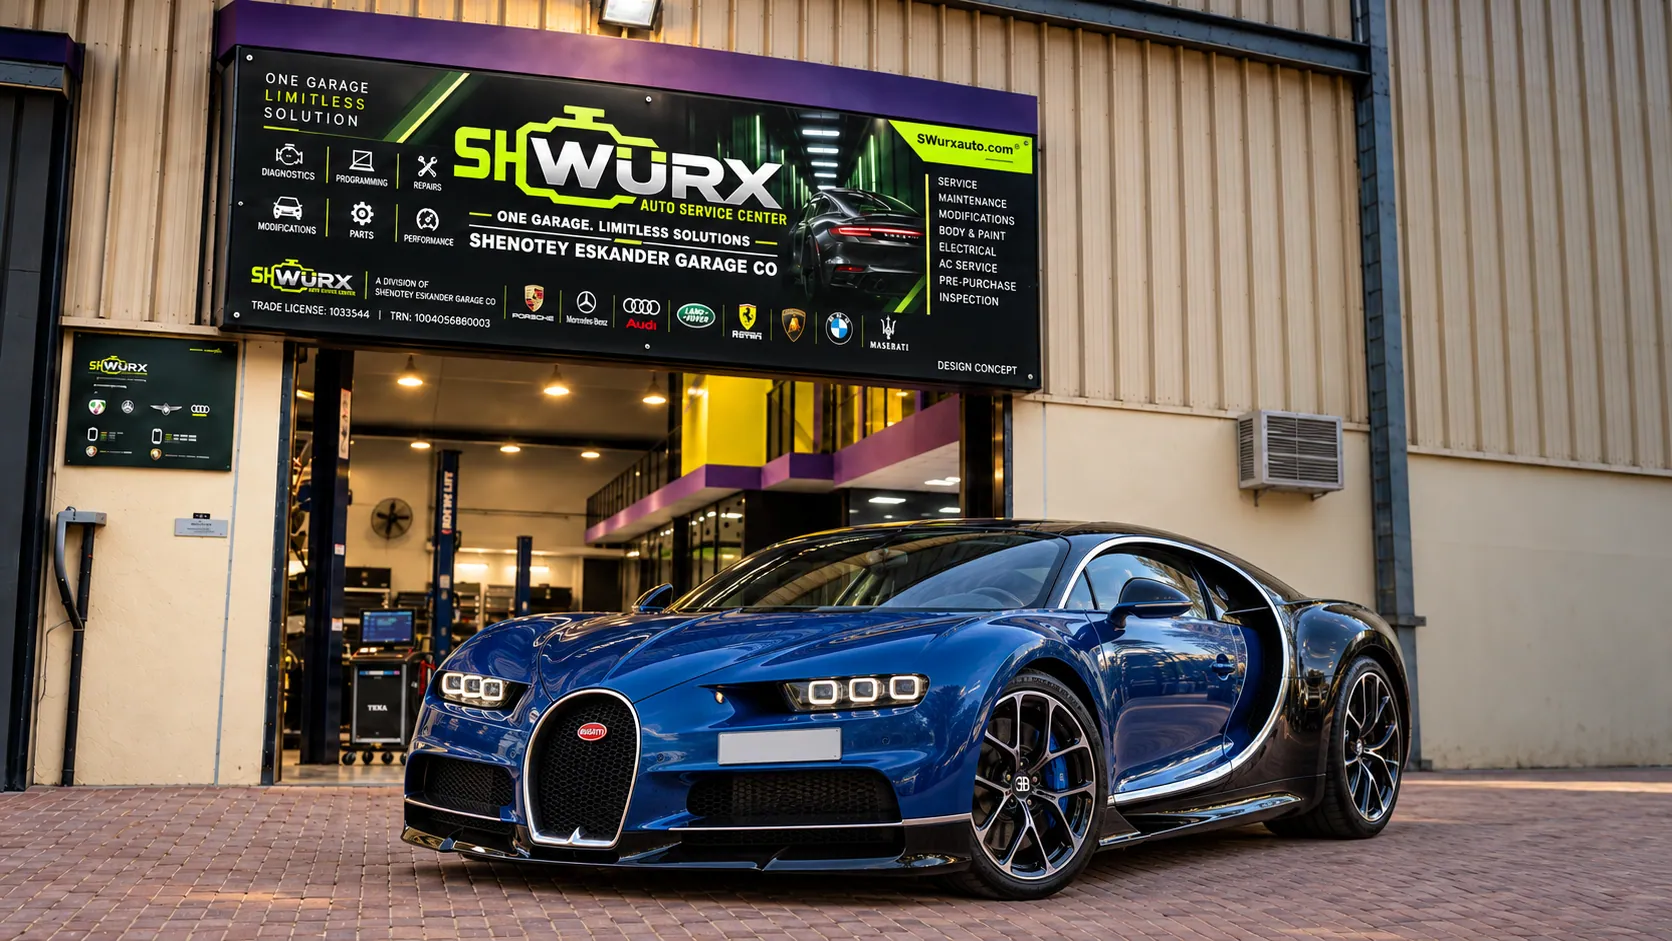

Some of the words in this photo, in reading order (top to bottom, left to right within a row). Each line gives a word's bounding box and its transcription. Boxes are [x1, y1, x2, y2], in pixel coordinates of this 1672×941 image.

[266, 73, 299, 86] ONE
[307, 76, 369, 93] GARAGE
[265, 89, 365, 110] LIMITLESS
[265, 107, 358, 126] SOLUTION
[917, 134, 1013, 154] SWurxauto.com
[262, 168, 315, 180] DIAGNOSTICS
[336, 174, 388, 187] PROGRAMMING
[414, 181, 442, 191] REPAIRS
[938, 177, 977, 189] SERVICE
[939, 194, 1007, 208] MAINTENANCE
[640, 199, 675, 214] AUTO
[680, 203, 733, 219] SERVICE
[738, 210, 787, 225] CENTER
[939, 210, 1015, 225] MODIFICATIONS
[258, 222, 316, 235] MODIFICATIONS
[350, 230, 374, 239] PARTS
[497, 211, 527, 224] ONE
[532, 214, 594, 231] GARAGE.
[599, 221, 668, 238] LIMITLESS
[673, 229, 750, 247] SOLUTIONS
[939, 226, 965, 237] BODY
[968, 229, 975, 238] &
[978, 230, 1005, 241] PAINT
[404, 235, 454, 246] PERFORMANCE
[469, 233, 568, 256] SHENOTEY
[576, 245, 669, 267] ESKANDER
[675, 253, 747, 274] GARAGE
[753, 261, 777, 277] CO
[939, 242, 996, 257] ELECTRICAL
[939, 259, 952, 269] AC
[956, 261, 997, 273] SERVICE
[376, 277, 381, 285] A
[383, 278, 416, 287] DIVISION
[940, 276, 1016, 291] PRE-PURCHASE
[375, 288, 413, 298] SHENOTEY
[416, 292, 453, 302] ESKANDER
[455, 295, 483, 304] GARAGE
[940, 293, 999, 306] INSPECTION
[251, 301, 282, 312] TRADE
[285, 303, 326, 315] LICENSE:
[330, 307, 370, 319] 1033544
[390, 311, 412, 322] TRN:
[626, 318, 657, 331] Audi
[870, 341, 908, 351] MASERATI
[938, 361, 971, 372] DESIGN
[975, 363, 1017, 375] CONCEPT
